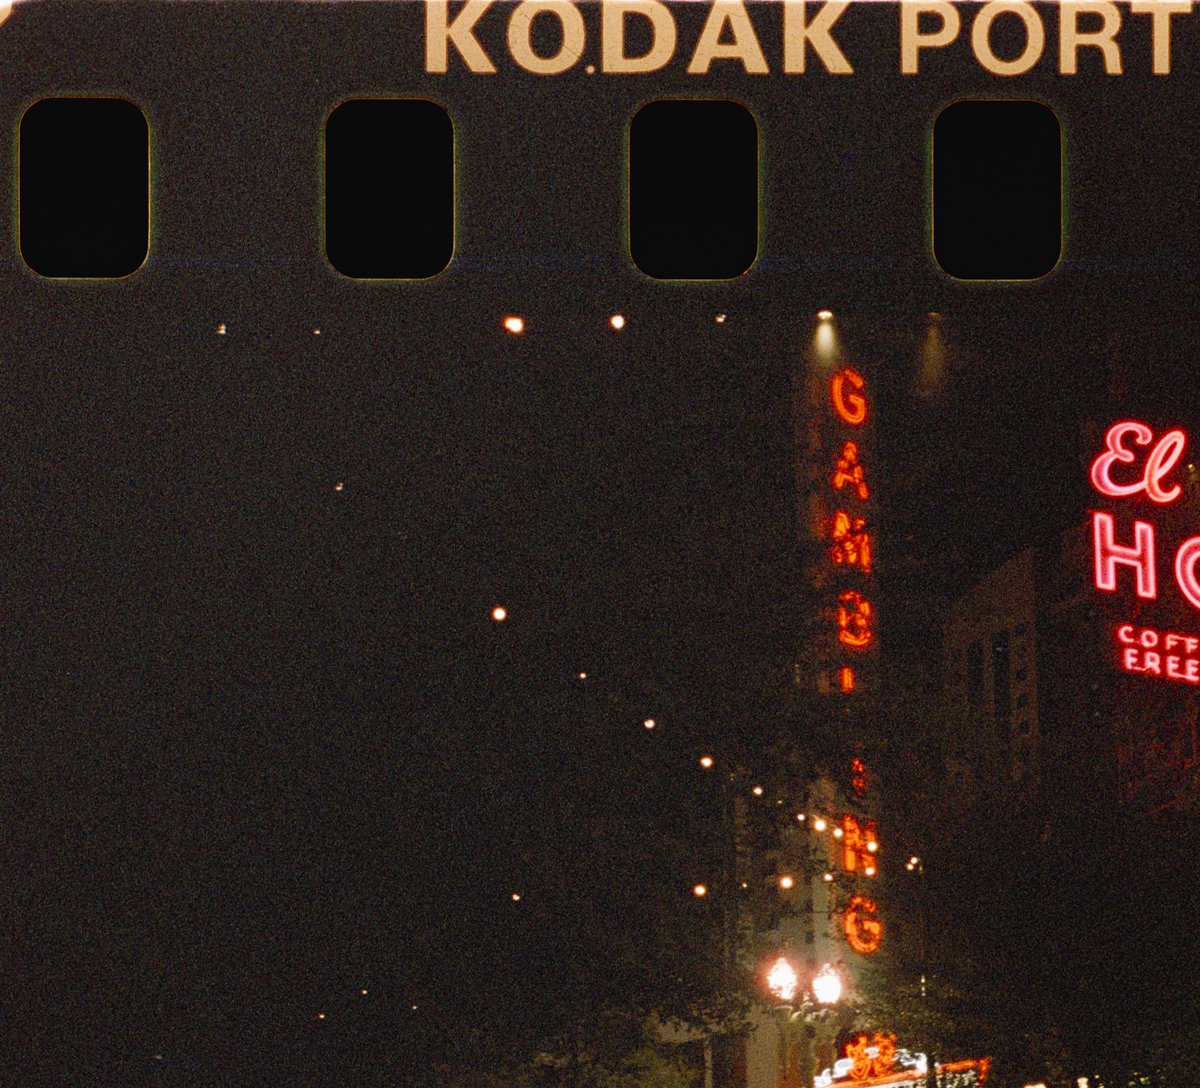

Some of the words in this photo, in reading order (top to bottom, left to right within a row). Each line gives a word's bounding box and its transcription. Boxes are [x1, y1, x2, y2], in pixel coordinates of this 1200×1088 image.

[426, 0, 854, 74] KODAK
[1091, 421, 1186, 503] El
[831, 367, 883, 953] GAMBING
[1124, 648, 1200, 682] FREE
